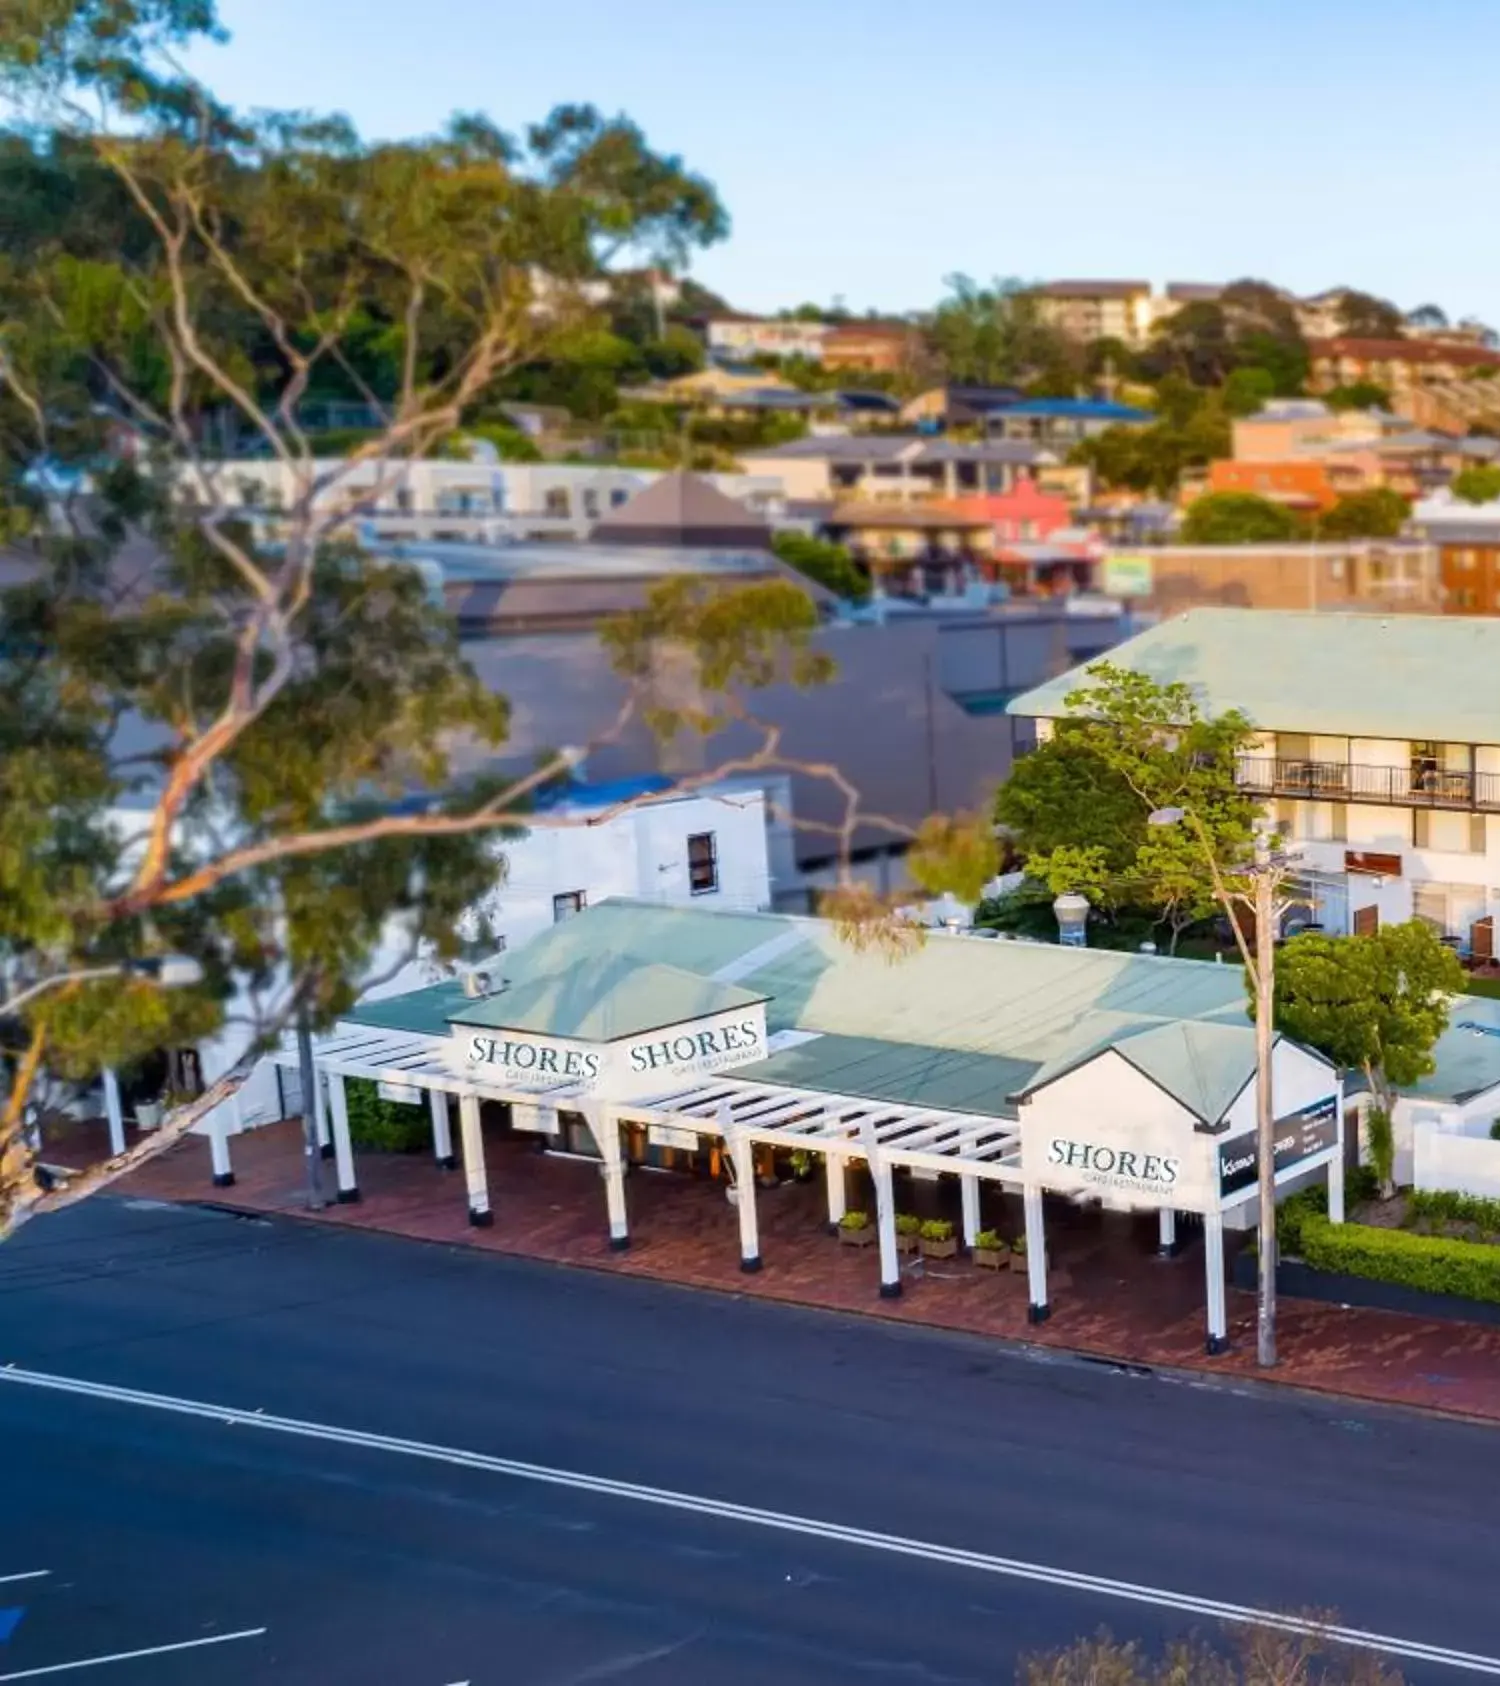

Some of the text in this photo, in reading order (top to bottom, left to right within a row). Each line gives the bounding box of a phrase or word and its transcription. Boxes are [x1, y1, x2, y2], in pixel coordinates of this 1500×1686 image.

[469, 1037, 599, 1078] SHORES
[630, 1021, 758, 1073] SHORES
[1048, 1138, 1179, 1183] SHORES
